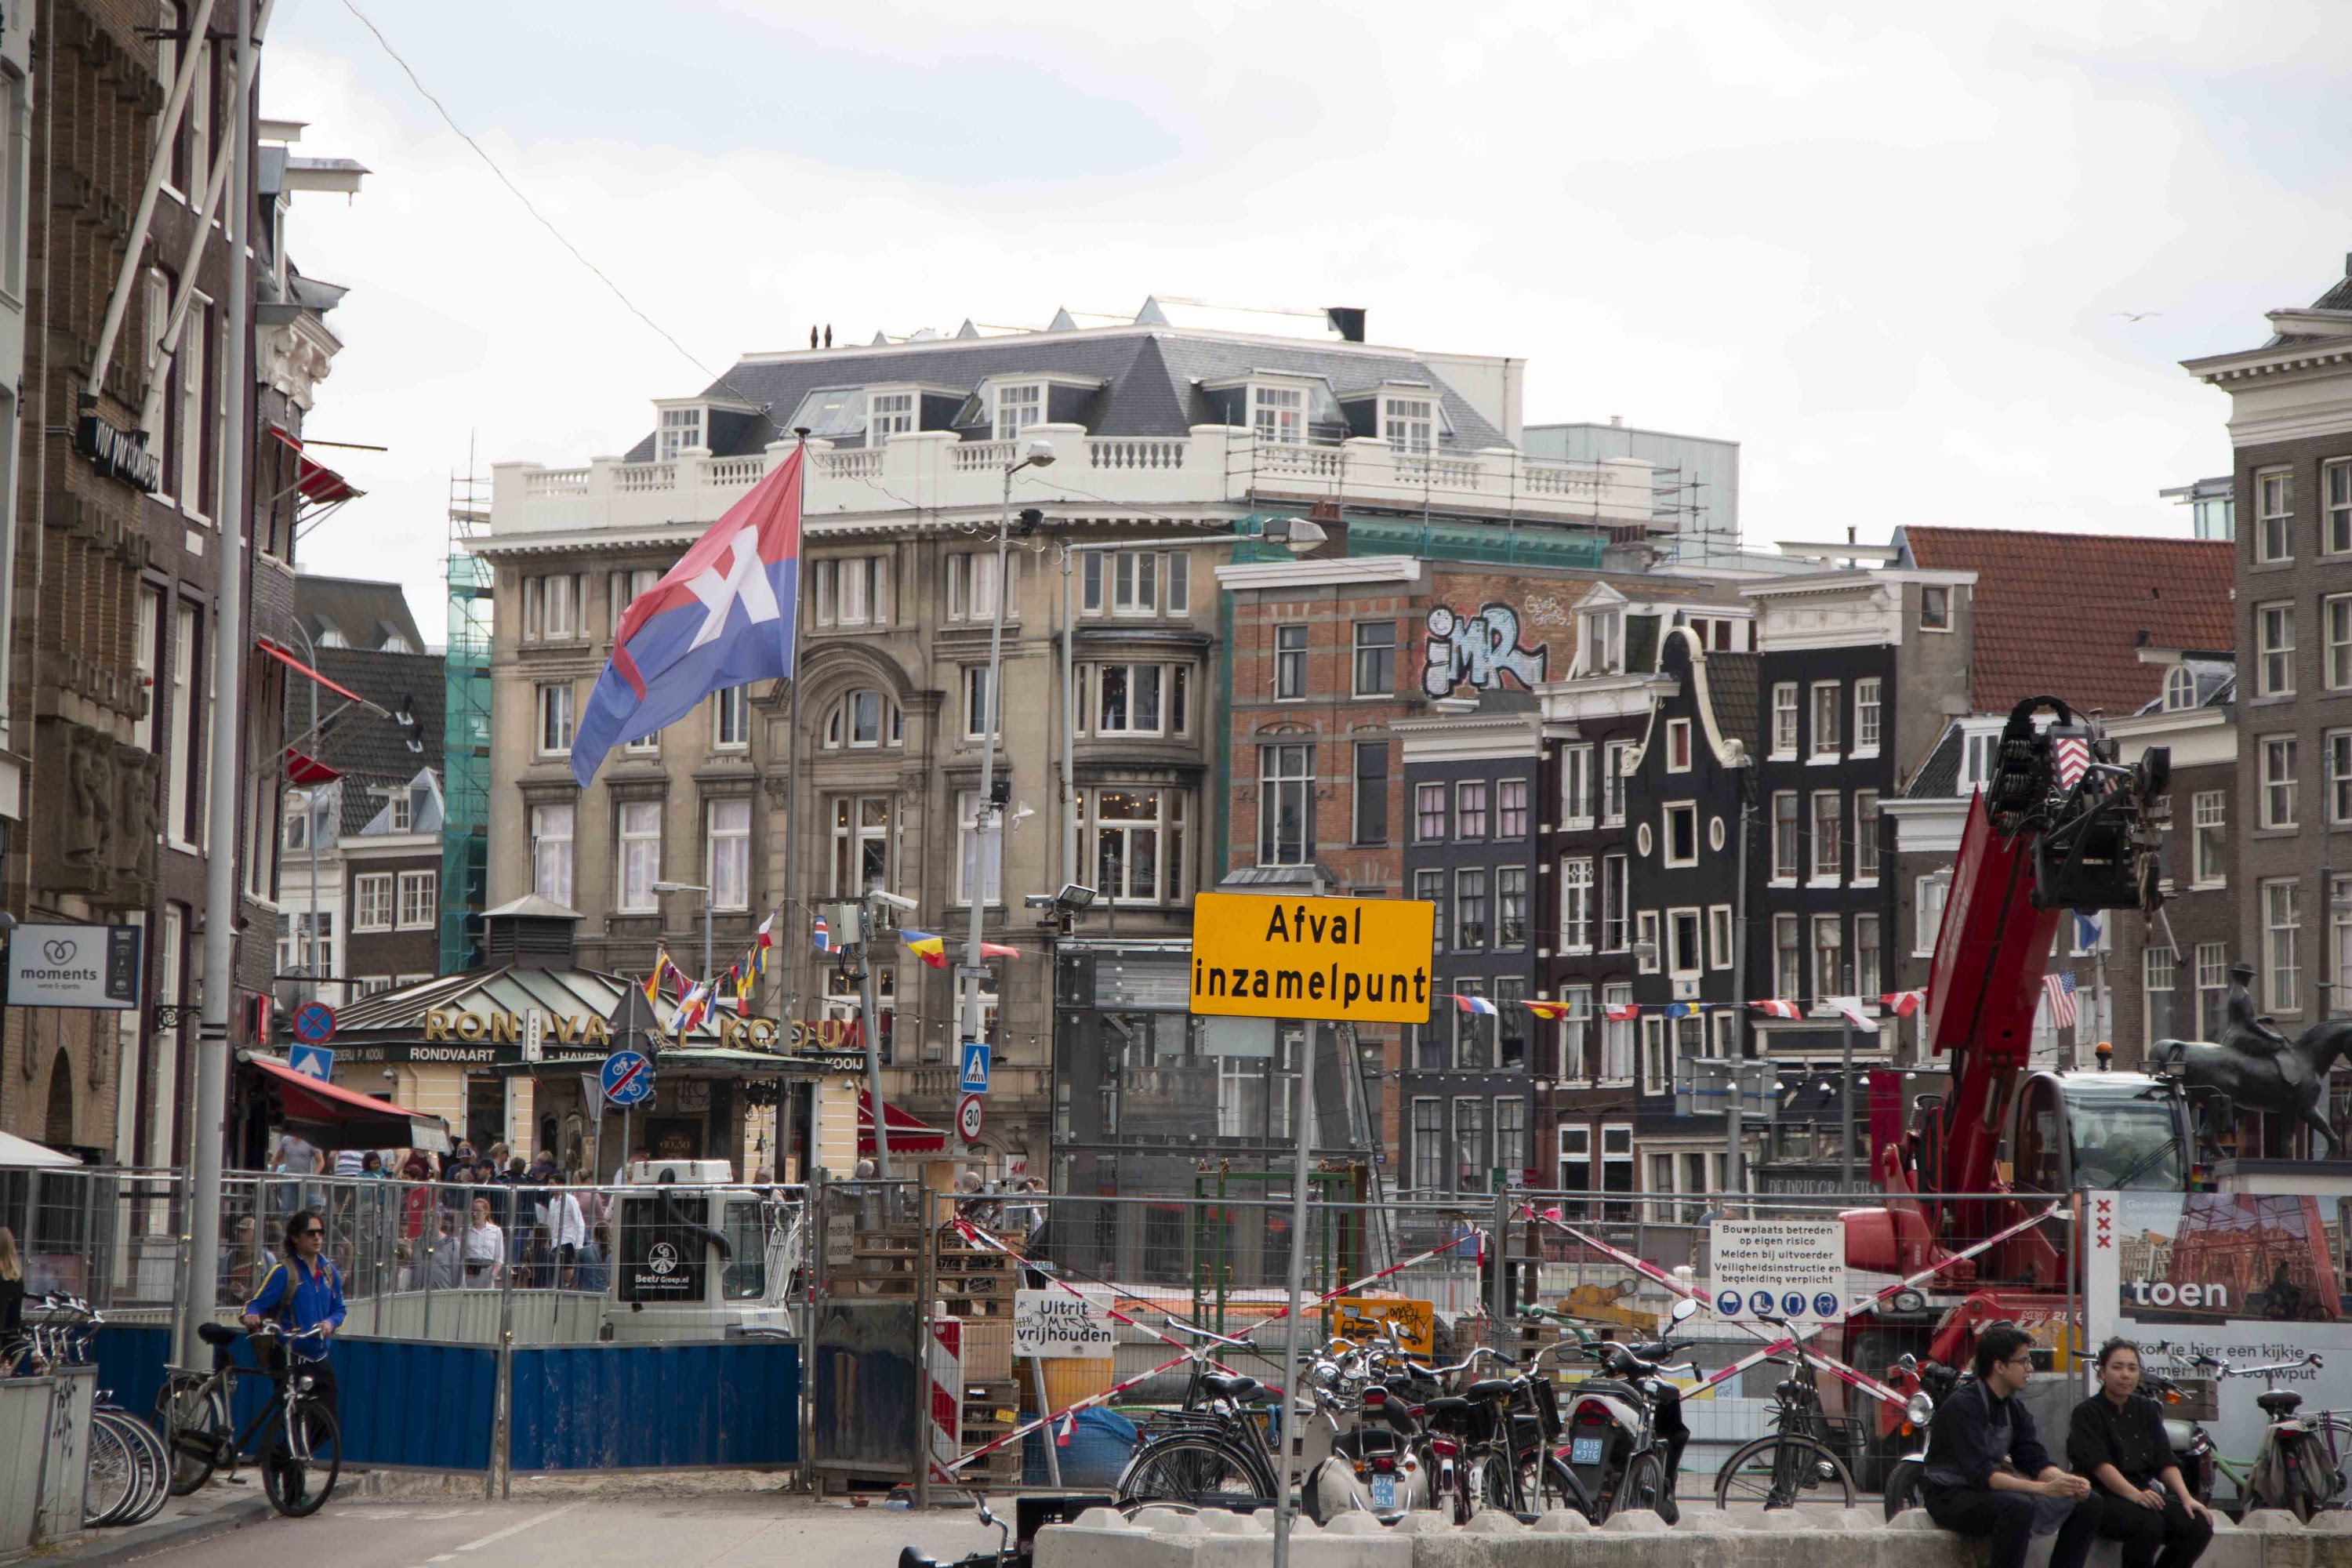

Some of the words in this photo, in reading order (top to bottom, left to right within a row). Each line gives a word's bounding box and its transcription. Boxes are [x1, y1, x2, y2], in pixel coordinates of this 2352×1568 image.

[1265, 904, 1361, 945] Afval
[21, 967, 97, 980] moments
[1195, 958, 1426, 1010] inzamelpunt
[410, 1047, 495, 1062] RONDVAART
[966, 1109, 979, 1127] 30
[1722, 1225, 1784, 1235] Bouwplaats
[1787, 1225, 1833, 1234] betreden
[1755, 1237, 1783, 1247] eigen
[1721, 1250, 1759, 1258] Melden
[1762, 1250, 1775, 1261] bij
[1778, 1250, 1834, 1259] uitvoerder
[1714, 1262, 1826, 1274] Veiligheidsinstructie
[635, 1274, 659, 1283] Beets
[660, 1276, 689, 1285] Groep.nl
[1722, 1274, 1782, 1286] begeleiding
[1785, 1275, 1833, 1285] verplicht
[2132, 1276, 2227, 1307] toen
[1040, 1300, 1088, 1316] Uitrit
[1017, 1327, 1111, 1345] vrijhouden
[2190, 1341, 2221, 1356] hier
[2227, 1347, 2256, 1357] een
[2263, 1343, 2304, 1362] kijkje
[2243, 1364, 2317, 1383] bowput
[1583, 1441, 1599, 1450] D15
[1582, 1450, 1599, 1460] 3TG
[1374, 1478, 1393, 1487] D74
[1375, 1495, 1393, 1504] 5LT
